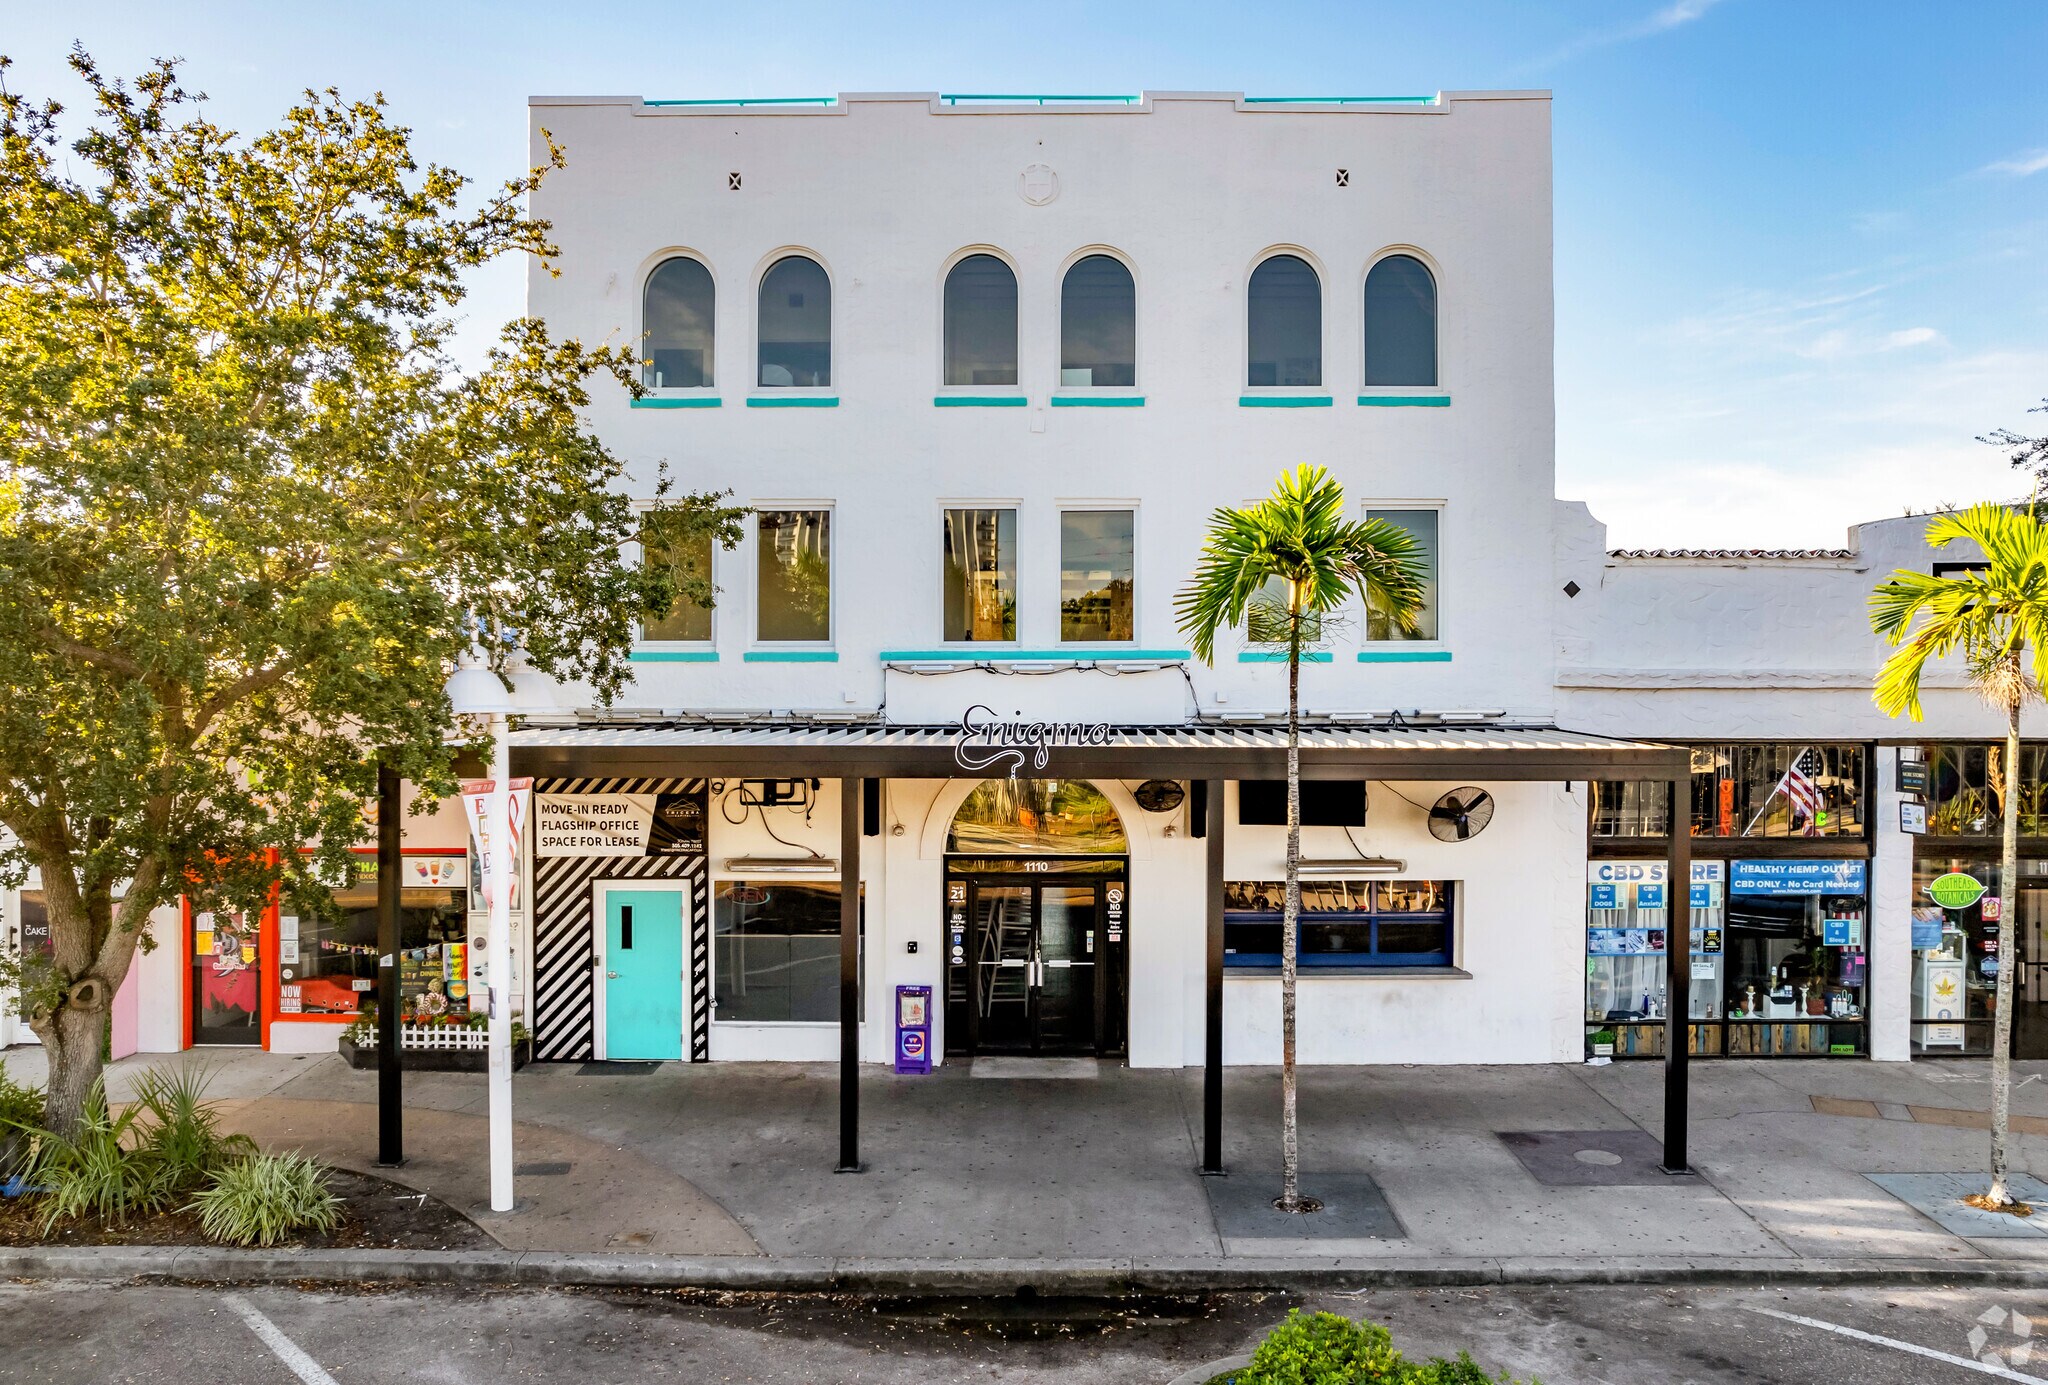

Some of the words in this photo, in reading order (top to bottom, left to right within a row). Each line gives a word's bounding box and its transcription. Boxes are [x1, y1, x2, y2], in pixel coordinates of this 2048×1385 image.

[955, 704, 1115, 779] Enigma
[541, 804, 589, 815] MOVE-IN
[592, 804, 629, 815] READY
[541, 820, 597, 831] FLAGSHIP
[599, 820, 640, 831] OFFICE
[541, 836, 579, 847] SPACE
[580, 836, 602, 847] FOR
[605, 836, 640, 847] LEASE
[1024, 862, 1048, 872] 1110
[1740, 865, 1787, 874] HEALTHY
[1788, 865, 1819, 874] HEMP
[1821, 865, 1862, 874] OUTLET
[1598, 865, 1644, 881] CBD
[1650, 865, 1718, 881] SRE
[1734, 880, 1755, 888] CBD
[1756, 880, 1781, 888] ONLY
[1787, 880, 1800, 888] No
[1802, 880, 1824, 888] Card
[1825, 880, 1860, 888] Needed
[1936, 877, 1976, 890] SOUTHEAST
[950, 890, 964, 899] 21
[1936, 890, 1975, 904] BOTANICALS
[1638, 900, 1662, 908] Anxiety
[24, 927, 48, 936] CAKE
[281, 985, 301, 998] NOW
[280, 998, 301, 1006] HIRING
